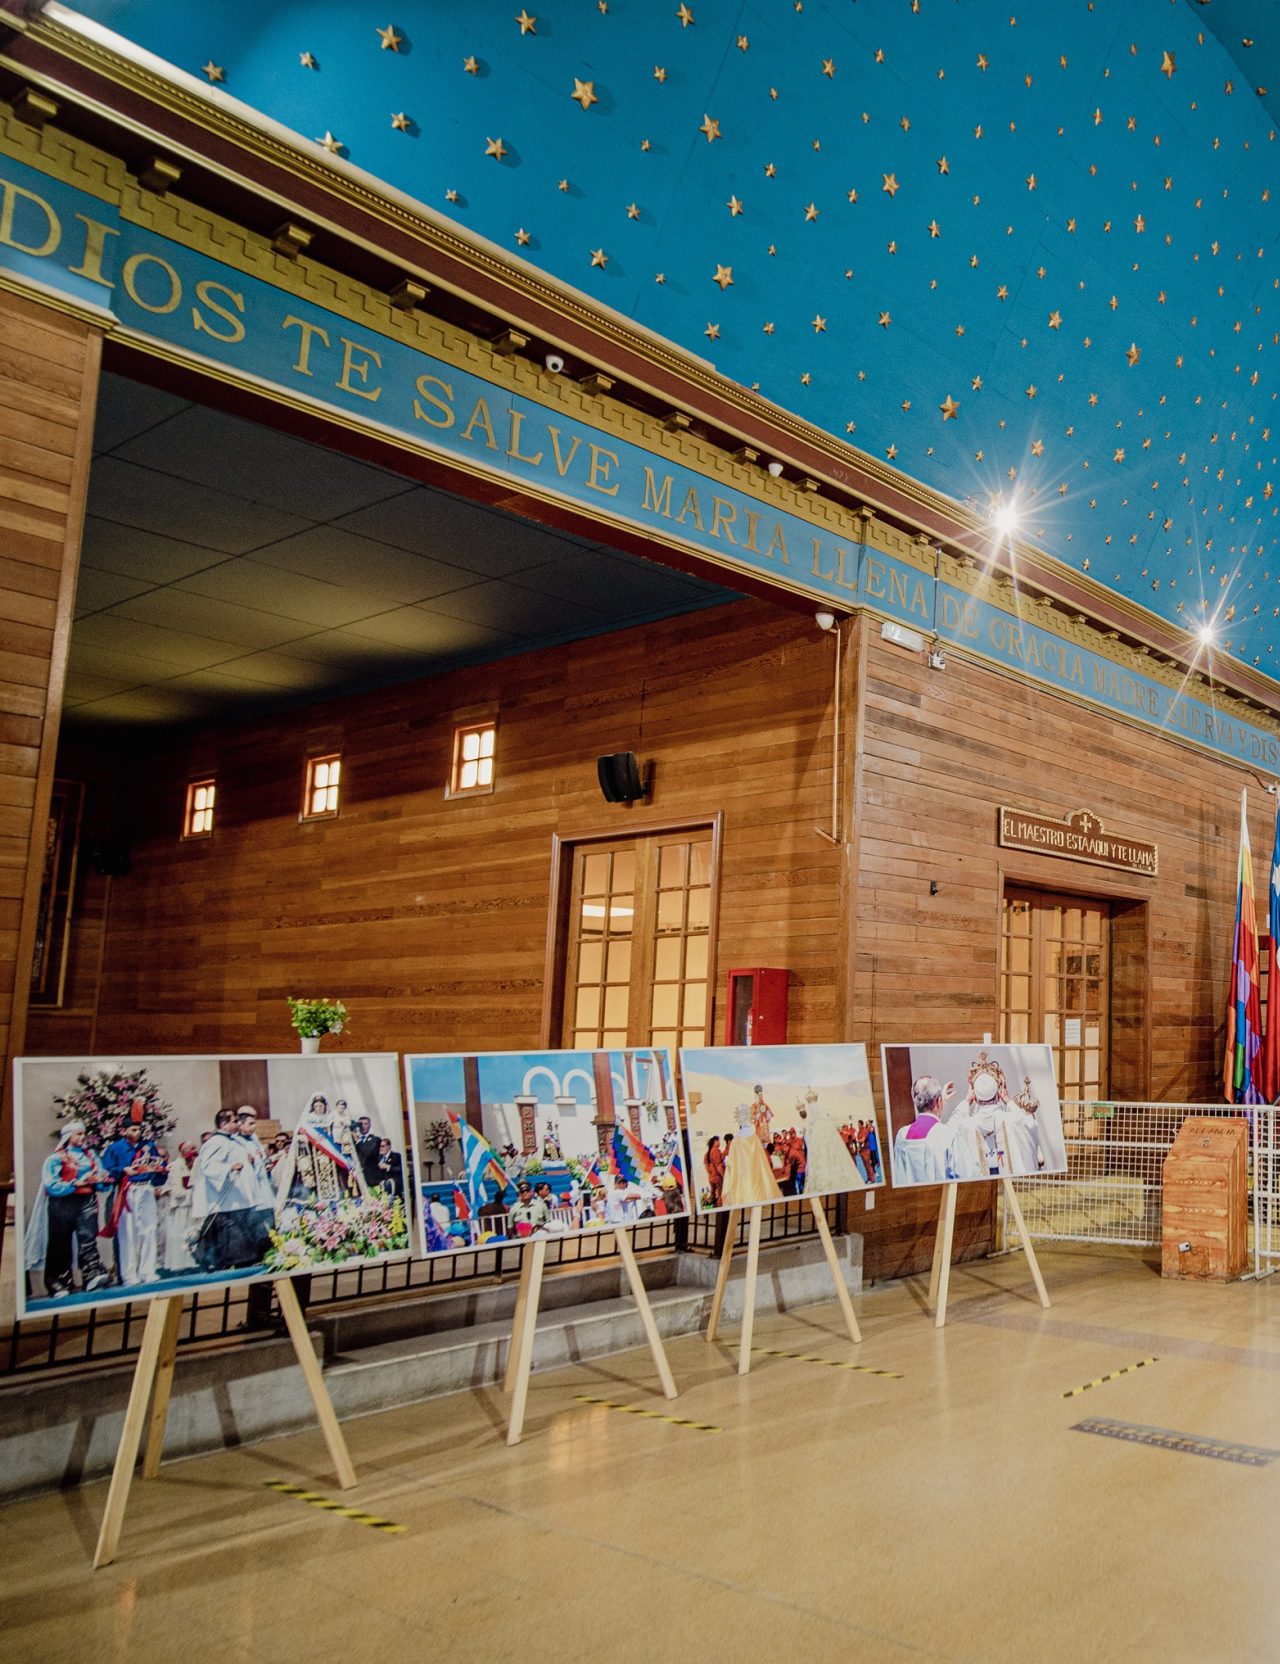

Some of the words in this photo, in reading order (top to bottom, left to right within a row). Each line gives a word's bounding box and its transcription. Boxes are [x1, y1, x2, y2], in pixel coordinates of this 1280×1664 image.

[0, 180, 246, 344] DIOS
[282, 315, 383, 402] TE
[413, 374, 620, 497] SALVE
[641, 466, 791, 565] MARIA
[810, 537, 929, 620] LLENA
[942, 594, 979, 640] DE
[988, 616, 1084, 684] GRACIA
[1093, 661, 1160, 717] MADRE
[1166, 697, 1235, 750] SIERVA
[1238, 728, 1248, 753] Y
[1003, 818, 1017, 838] EL
[1018, 822, 1065, 847] MAESTRO
[1111, 843, 1117, 856] Y
[1117, 844, 1128, 861] TE
[1128, 847, 1154, 865] LLAMA
